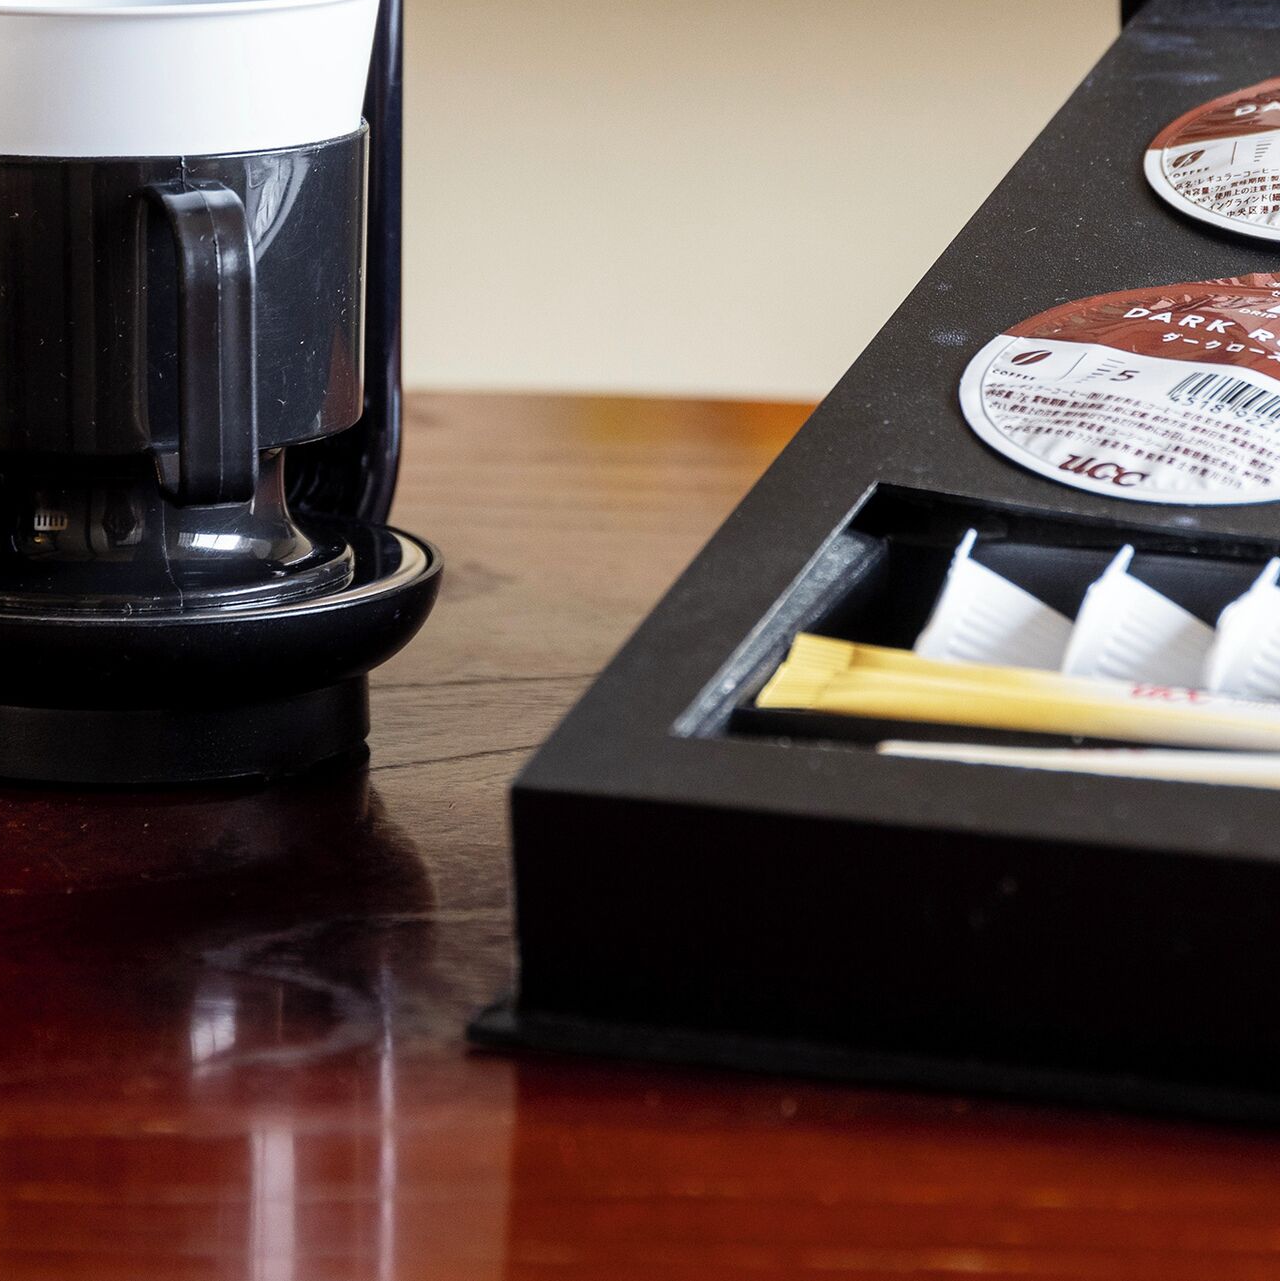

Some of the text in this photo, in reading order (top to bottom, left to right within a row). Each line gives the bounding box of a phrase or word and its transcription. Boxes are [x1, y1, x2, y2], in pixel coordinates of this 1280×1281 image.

[1122, 307, 1236, 335] DARK
[1238, 307, 1278, 321] DRIP
[1108, 369, 1141, 382] 5
